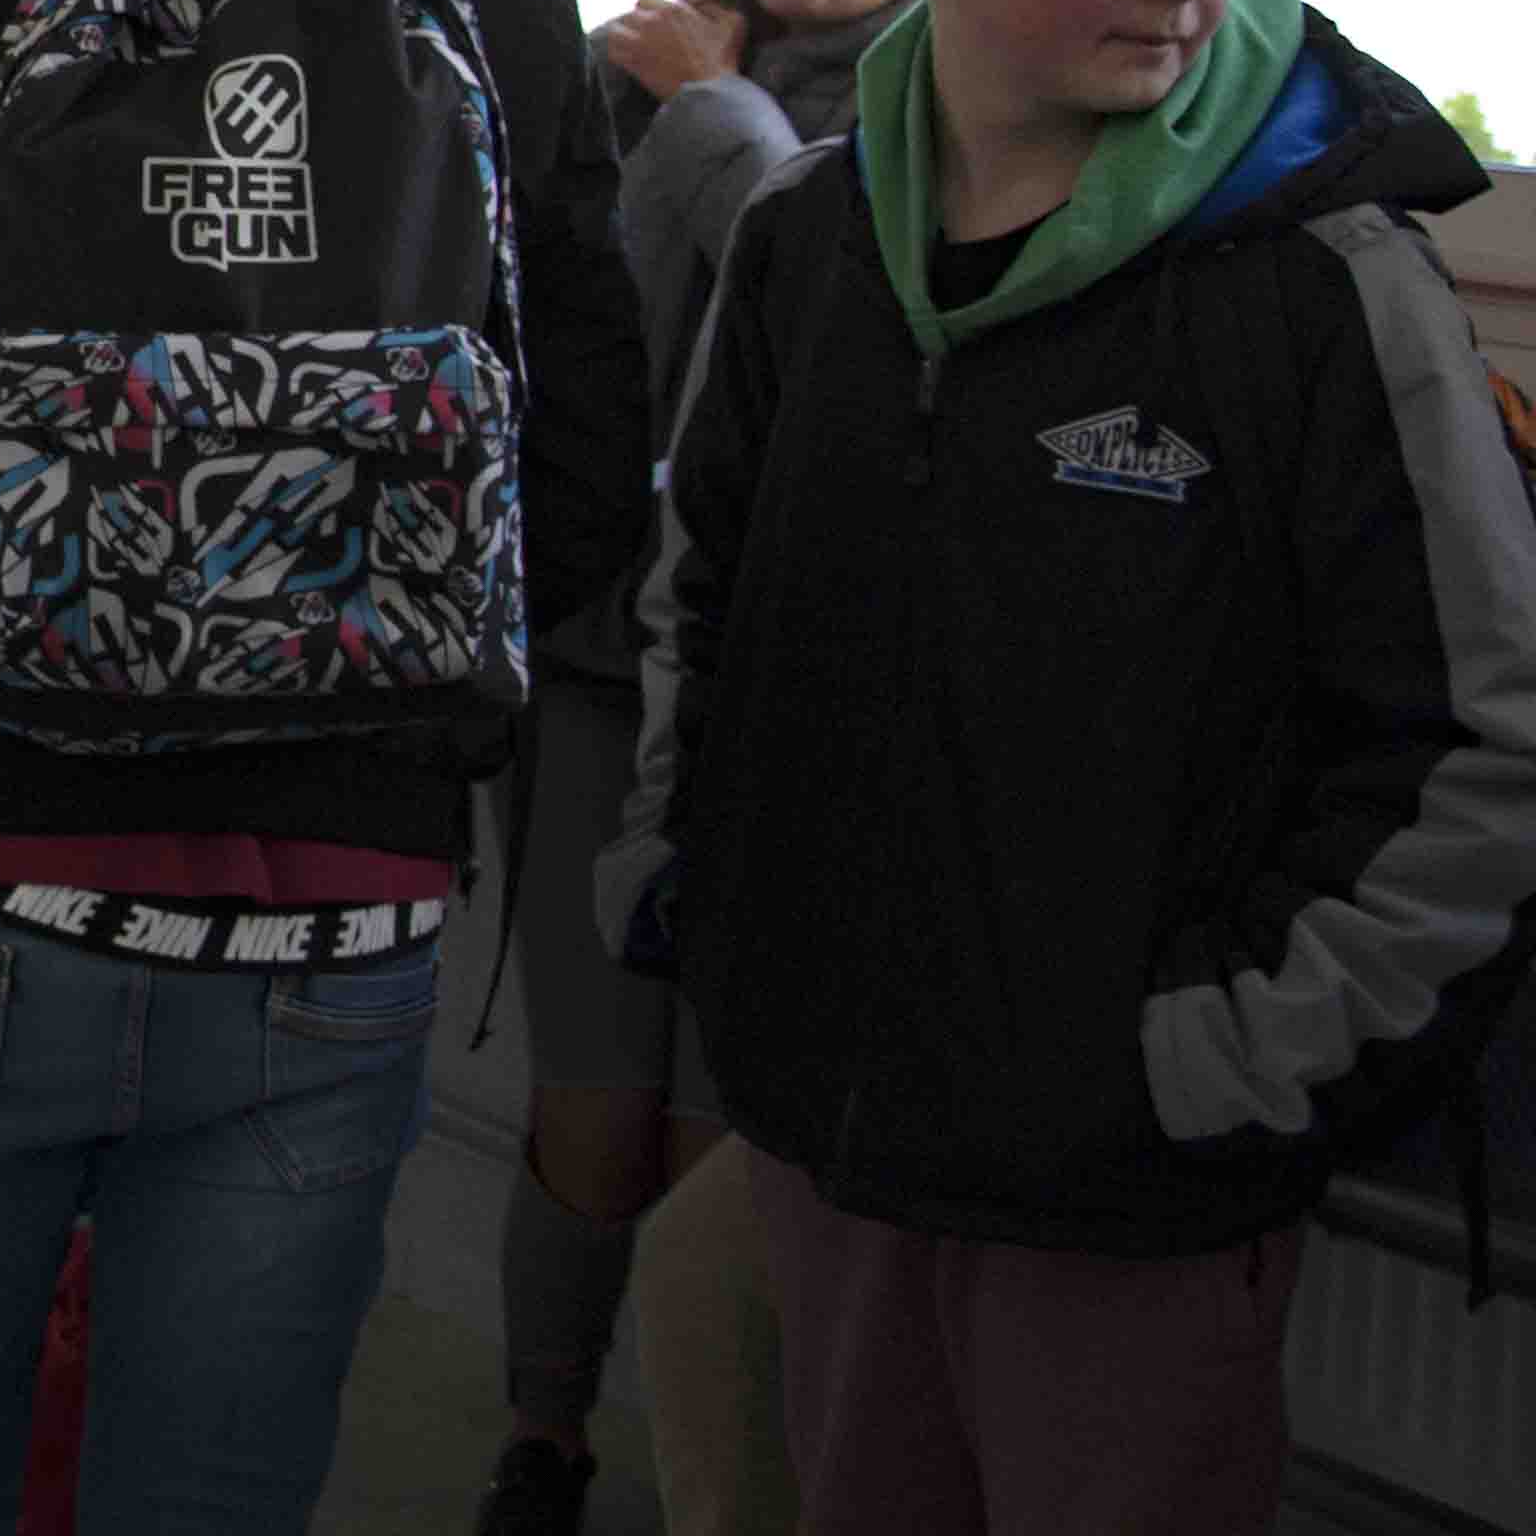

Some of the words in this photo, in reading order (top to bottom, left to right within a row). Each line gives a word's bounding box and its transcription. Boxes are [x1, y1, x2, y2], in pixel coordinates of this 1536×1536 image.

[144, 159, 312, 211] FREE
[172, 212, 316, 269] GUN
[1, 882, 107, 937] NIKE
[221, 913, 317, 962] NIKE
